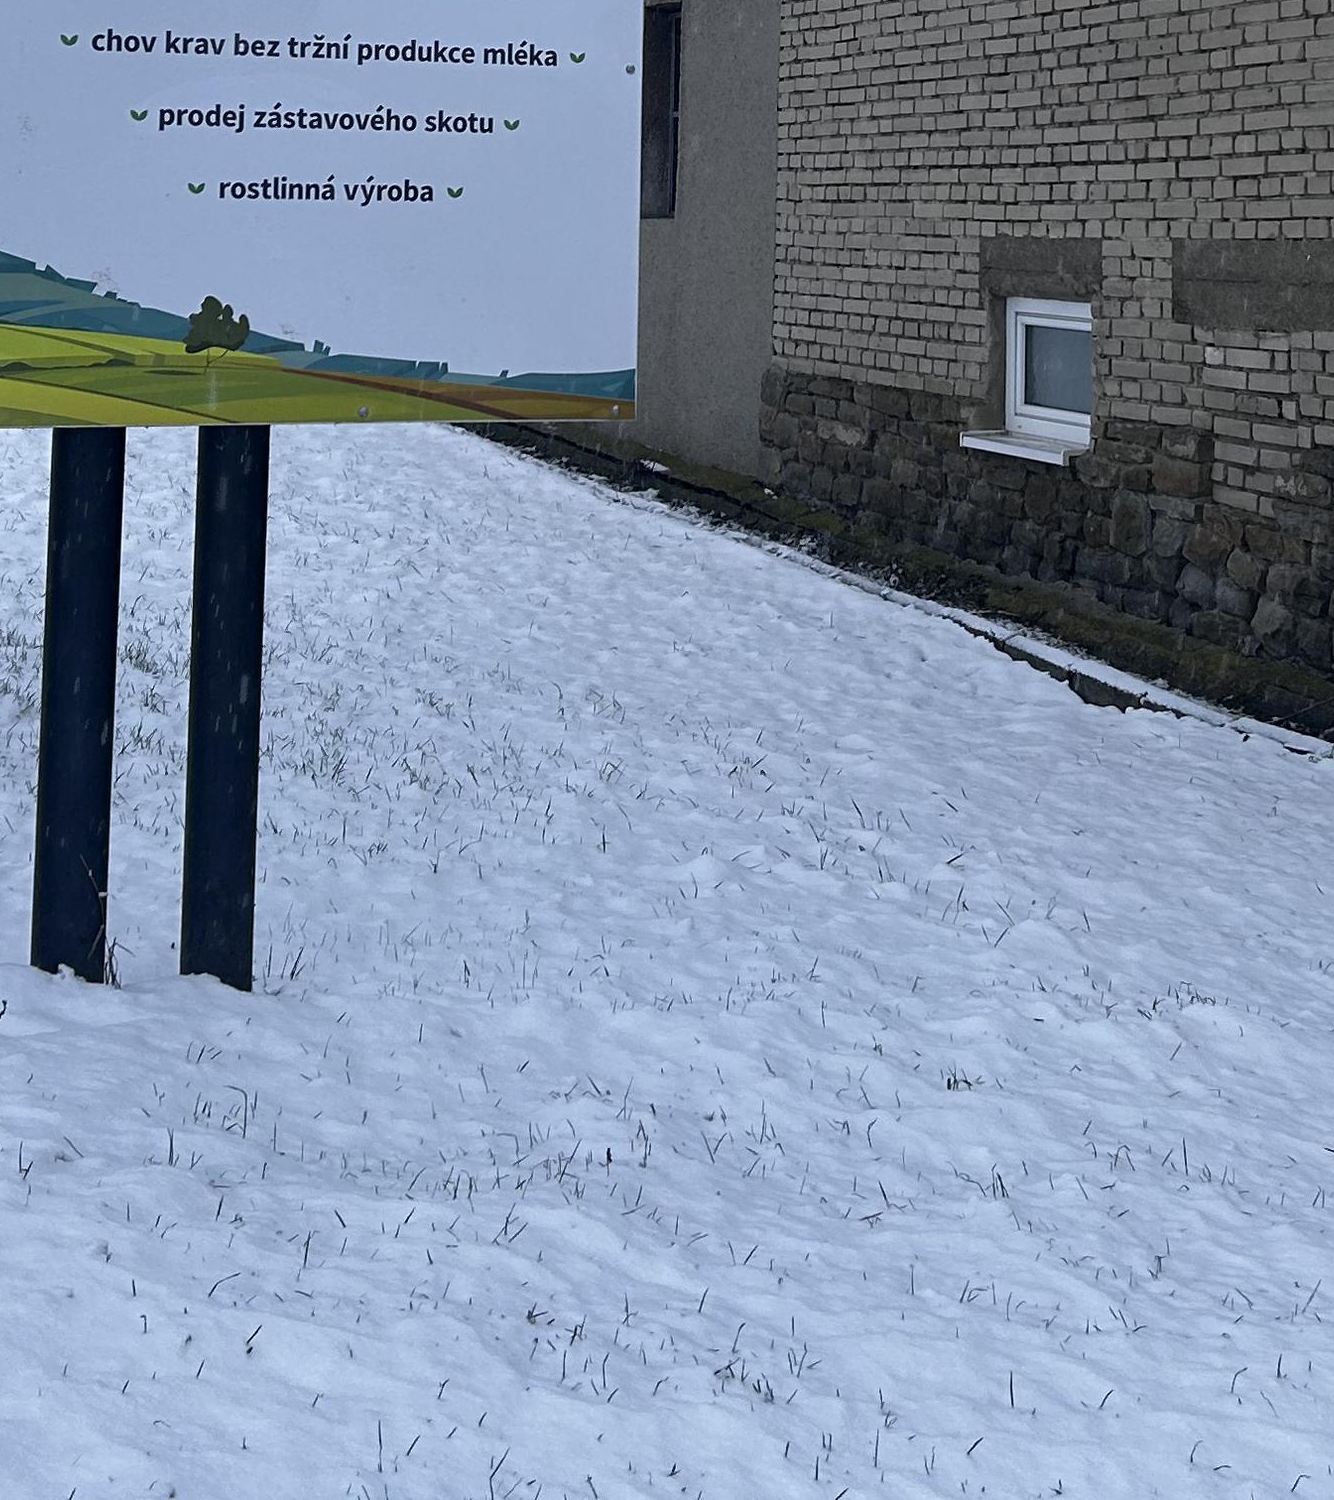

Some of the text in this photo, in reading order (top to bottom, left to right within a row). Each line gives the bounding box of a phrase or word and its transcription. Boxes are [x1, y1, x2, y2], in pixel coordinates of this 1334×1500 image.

[91, 28, 558, 67] chov krav bez tržní produkce mléka
[158, 101, 495, 135] prodej zástavového skotu
[218, 173, 434, 208] rostlinná výroba
